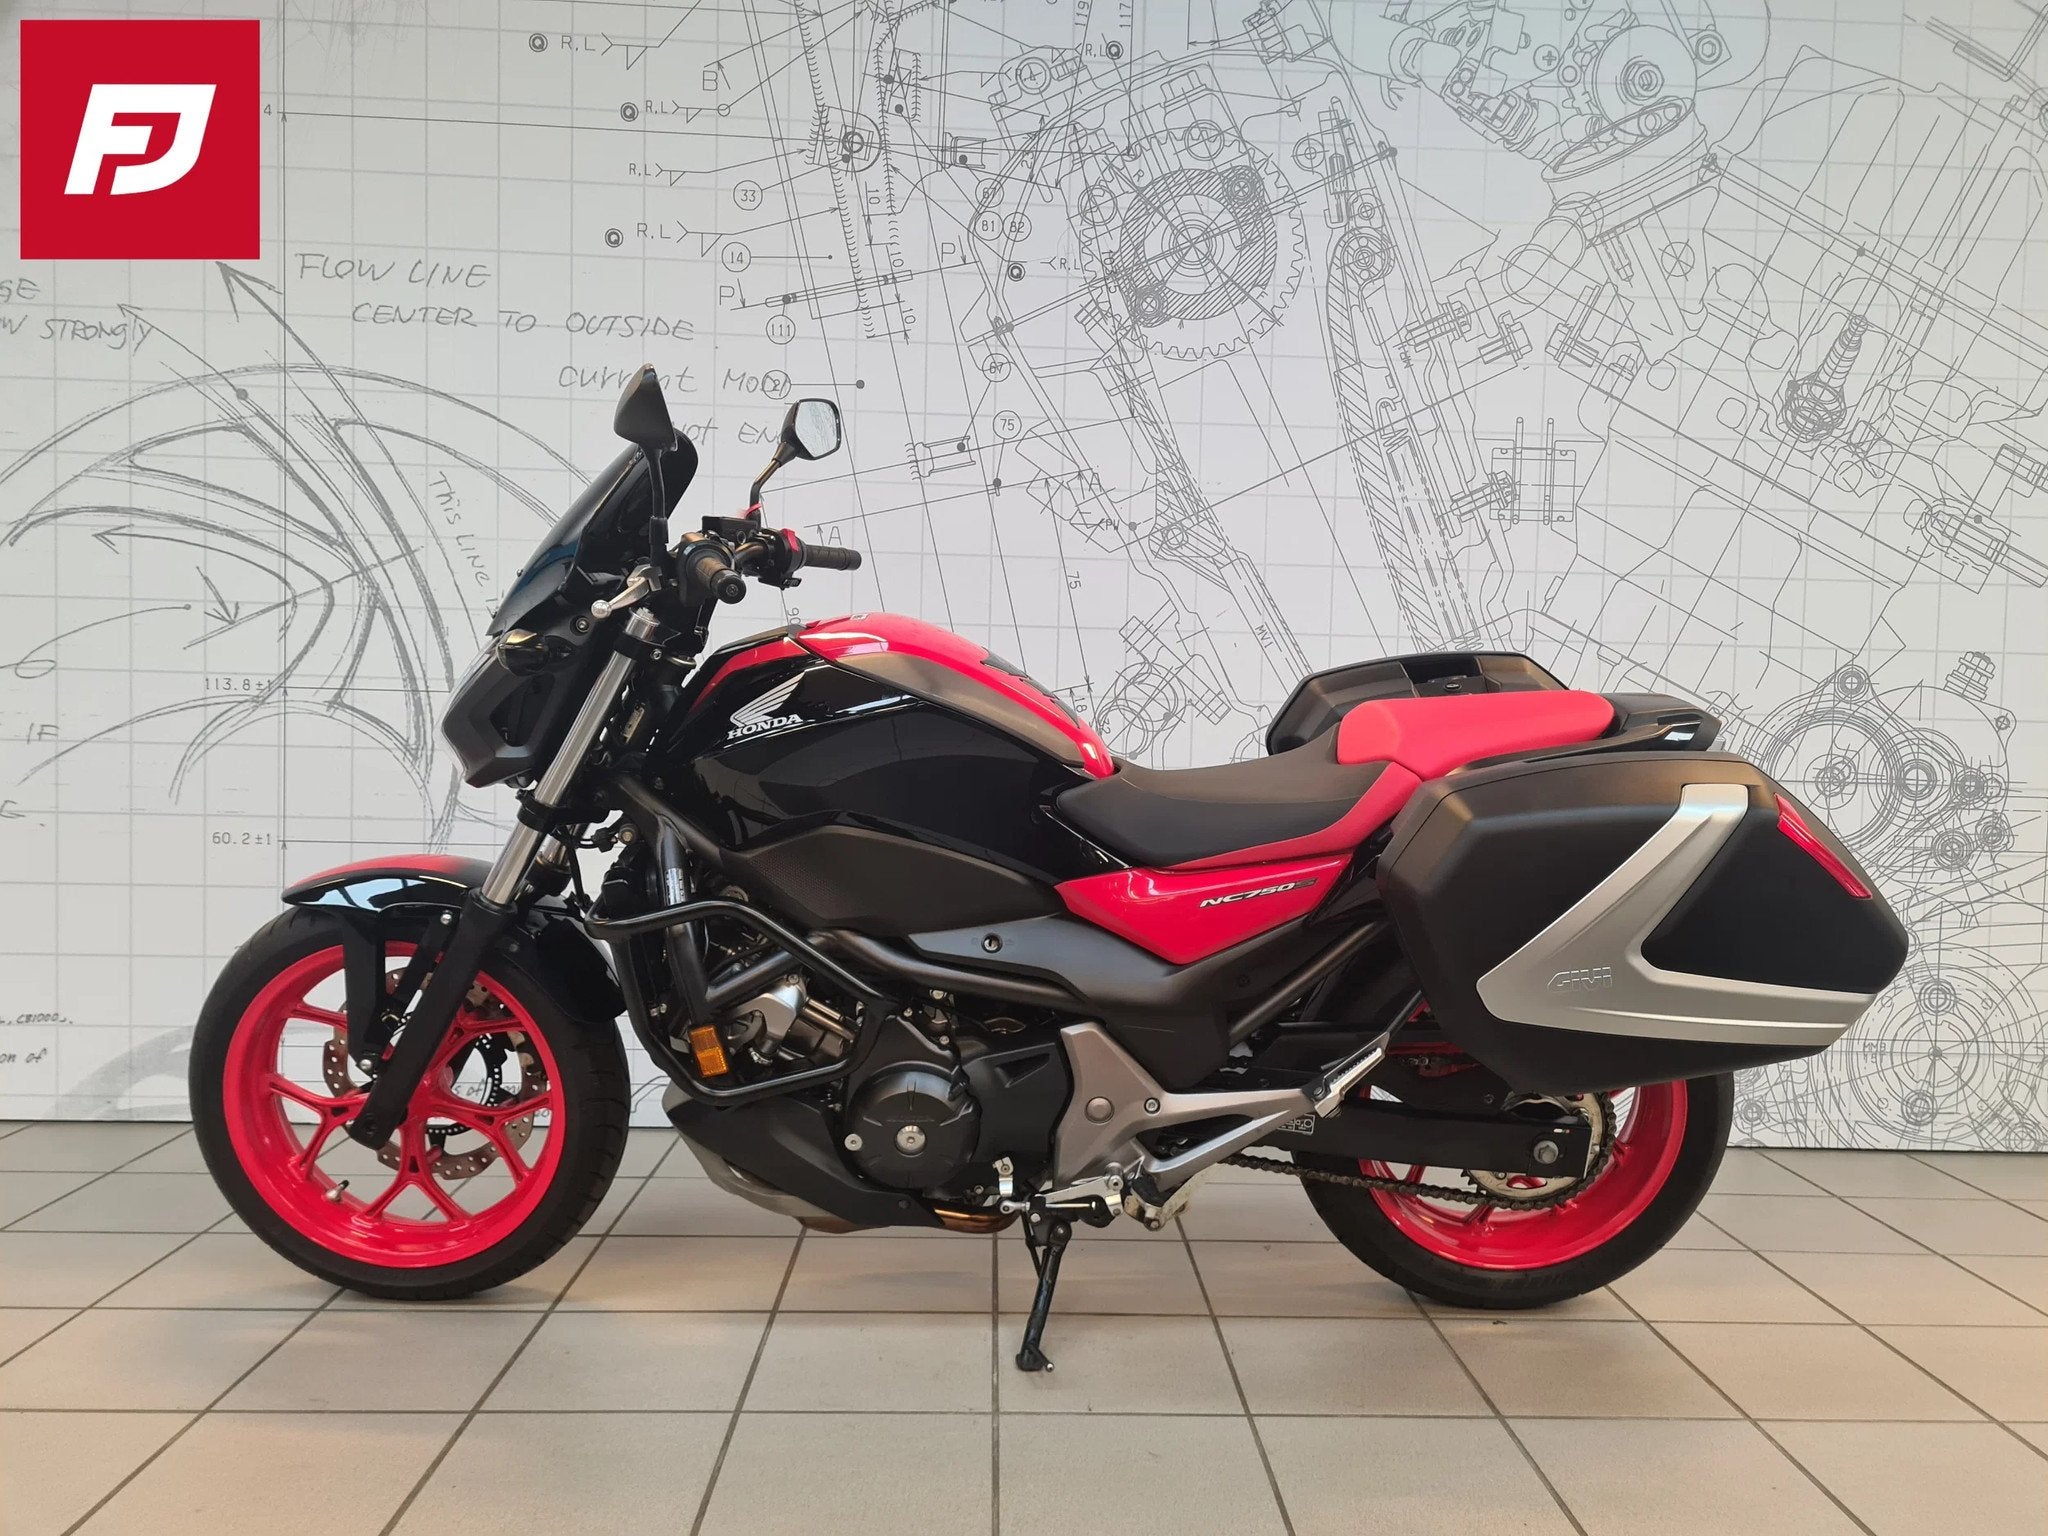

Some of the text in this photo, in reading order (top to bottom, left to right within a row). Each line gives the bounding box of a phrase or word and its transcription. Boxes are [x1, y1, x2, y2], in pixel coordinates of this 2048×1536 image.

[703, 71, 718, 92] B
[740, 188, 757, 202] 33
[981, 219, 996, 232] 81
[728, 251, 744, 264] 14
[941, 242, 956, 263] P
[294, 253, 491, 288] FLOW LINE
[719, 286, 735, 306] P
[351, 303, 695, 341] CENTER TO OUTSIDE
[828, 526, 842, 545] A
[727, 713, 804, 740] HONDA
